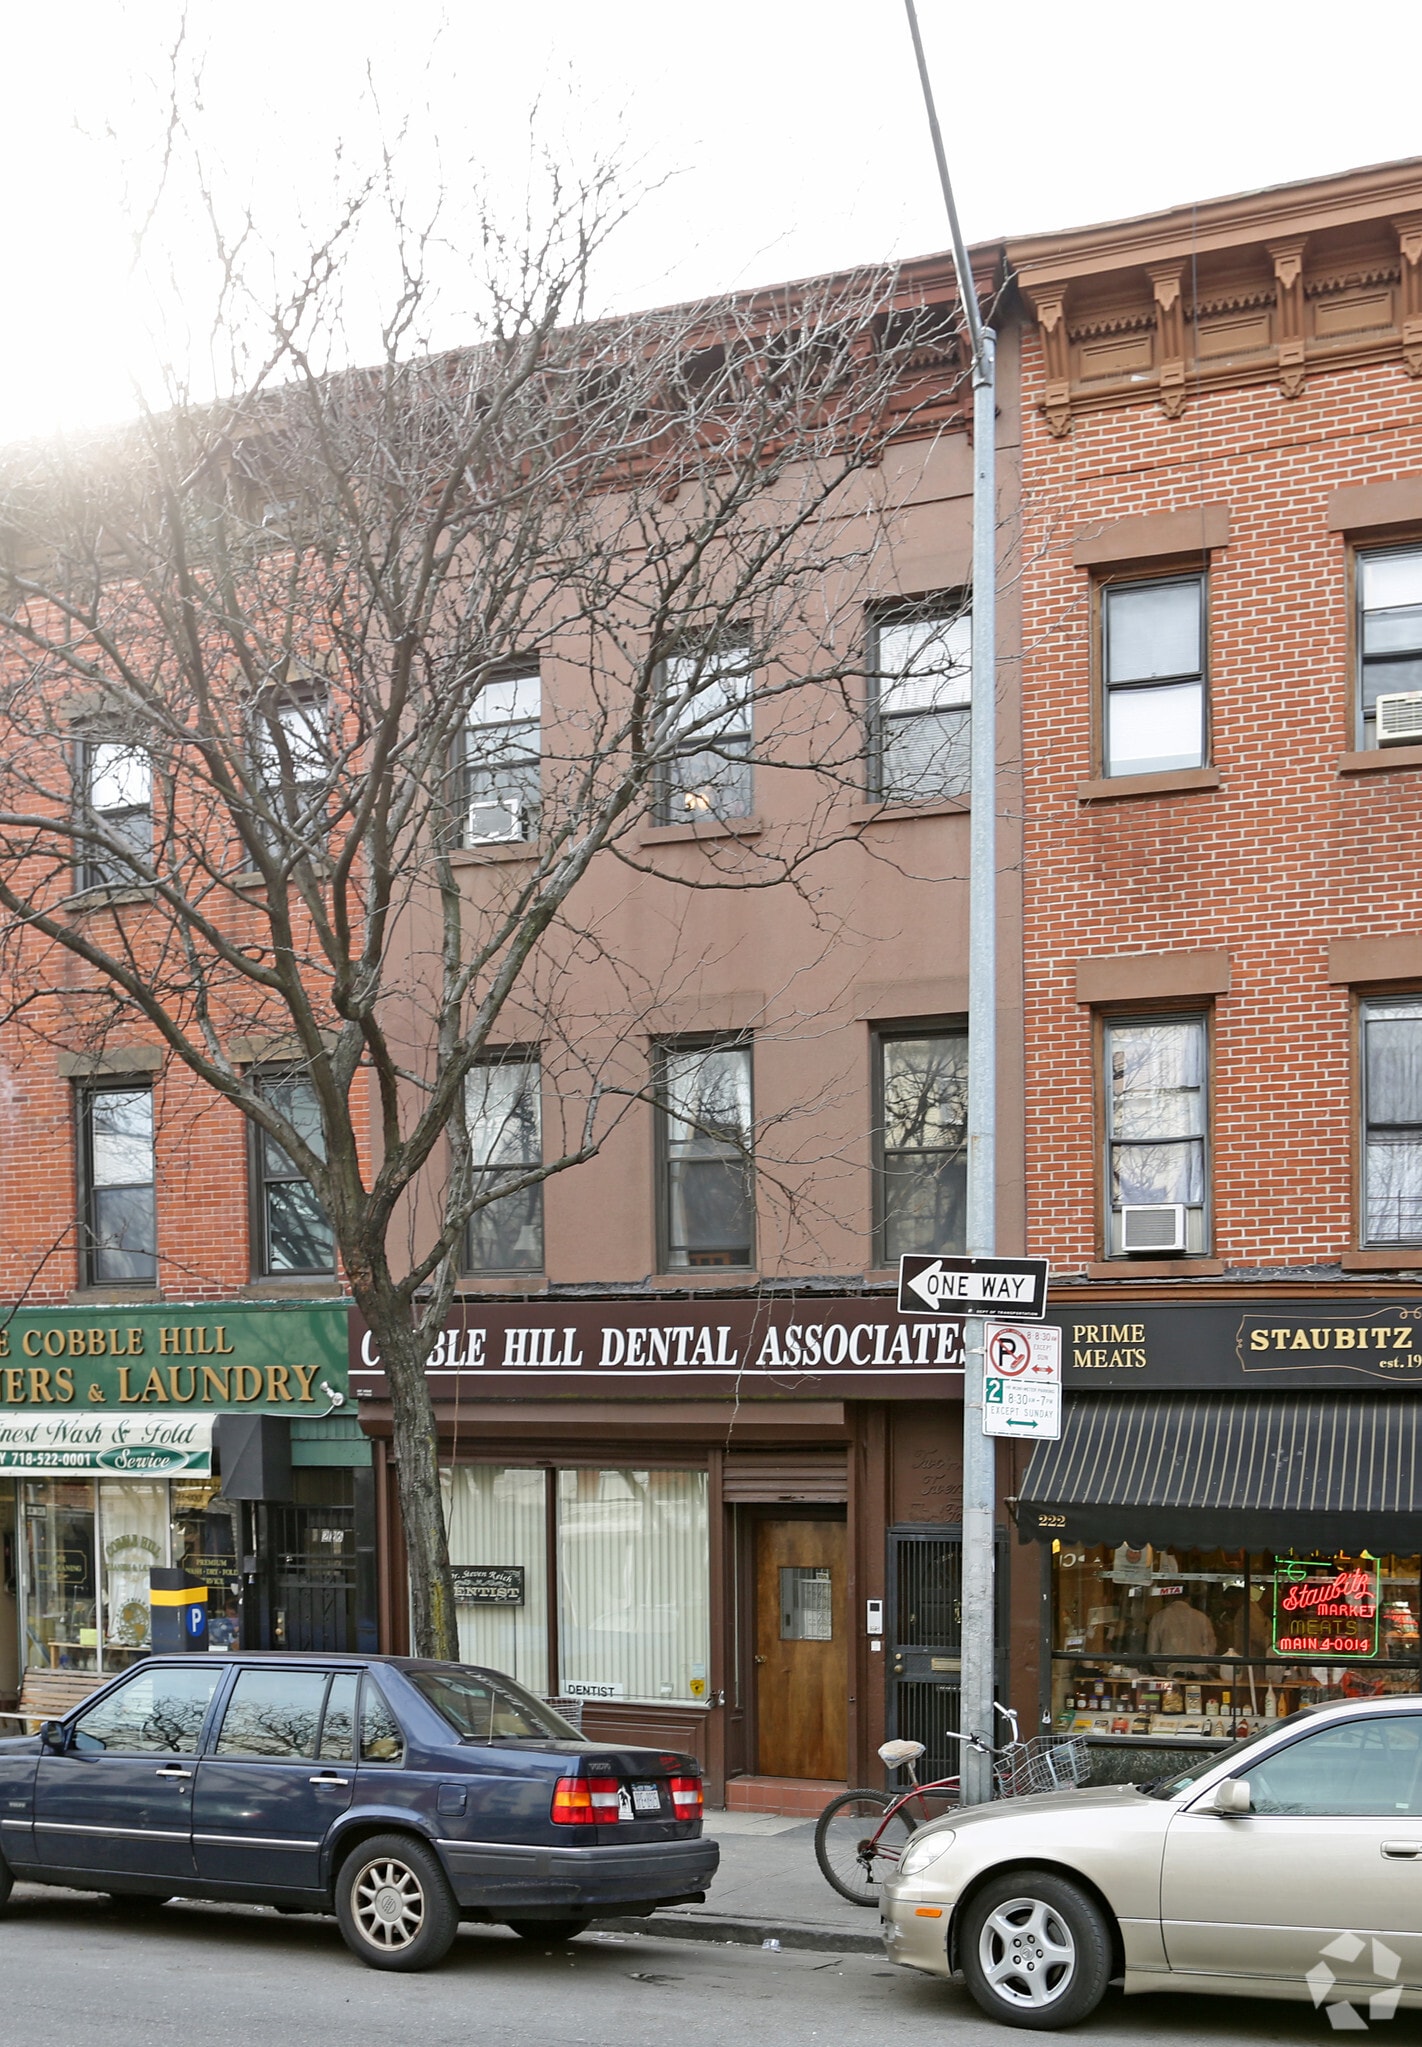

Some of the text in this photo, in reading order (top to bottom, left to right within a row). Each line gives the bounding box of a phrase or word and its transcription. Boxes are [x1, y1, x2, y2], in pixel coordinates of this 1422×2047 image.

[927, 1274, 1025, 1298] ONE WAY
[22, 1327, 144, 1357] COBBLE
[159, 1326, 236, 1355] HILL
[1072, 1324, 1146, 1344] PRIME
[1250, 1327, 1413, 1351] STAUBITZ
[360, 1323, 966, 1367] CBLE HILL DENTAL ASSOCIATE
[1072, 1349, 1147, 1368] MEATS
[0, 1365, 320, 1403] ERS & LAUNDRY
[988, 1380, 1000, 1401] 2
[991, 1405, 1054, 1419] EXCEPT SUNDAY
[46, 1419, 102, 1446] Wash
[111, 1419, 131, 1443] &
[141, 1419, 197, 1444] Fold
[11, 1452, 91, 1466] 718-522-0001
[114, 1449, 171, 1469] Service
[1038, 1514, 1066, 1527] 222
[196, 1559, 227, 1567] PREMIUM
[462, 1570, 487, 1579] Steven
[489, 1571, 512, 1582] Reich
[453, 1586, 520, 1598] ENTIST
[1159, 1586, 1182, 1595] MTA
[1282, 1567, 1375, 1611] Staubitz
[191, 1608, 202, 1632] P
[1317, 1603, 1377, 1618] MARKET
[1290, 1619, 1358, 1635] MEATS
[1280, 1638, 1318, 1650] MAIN
[568, 1684, 615, 1697] DENTIST
